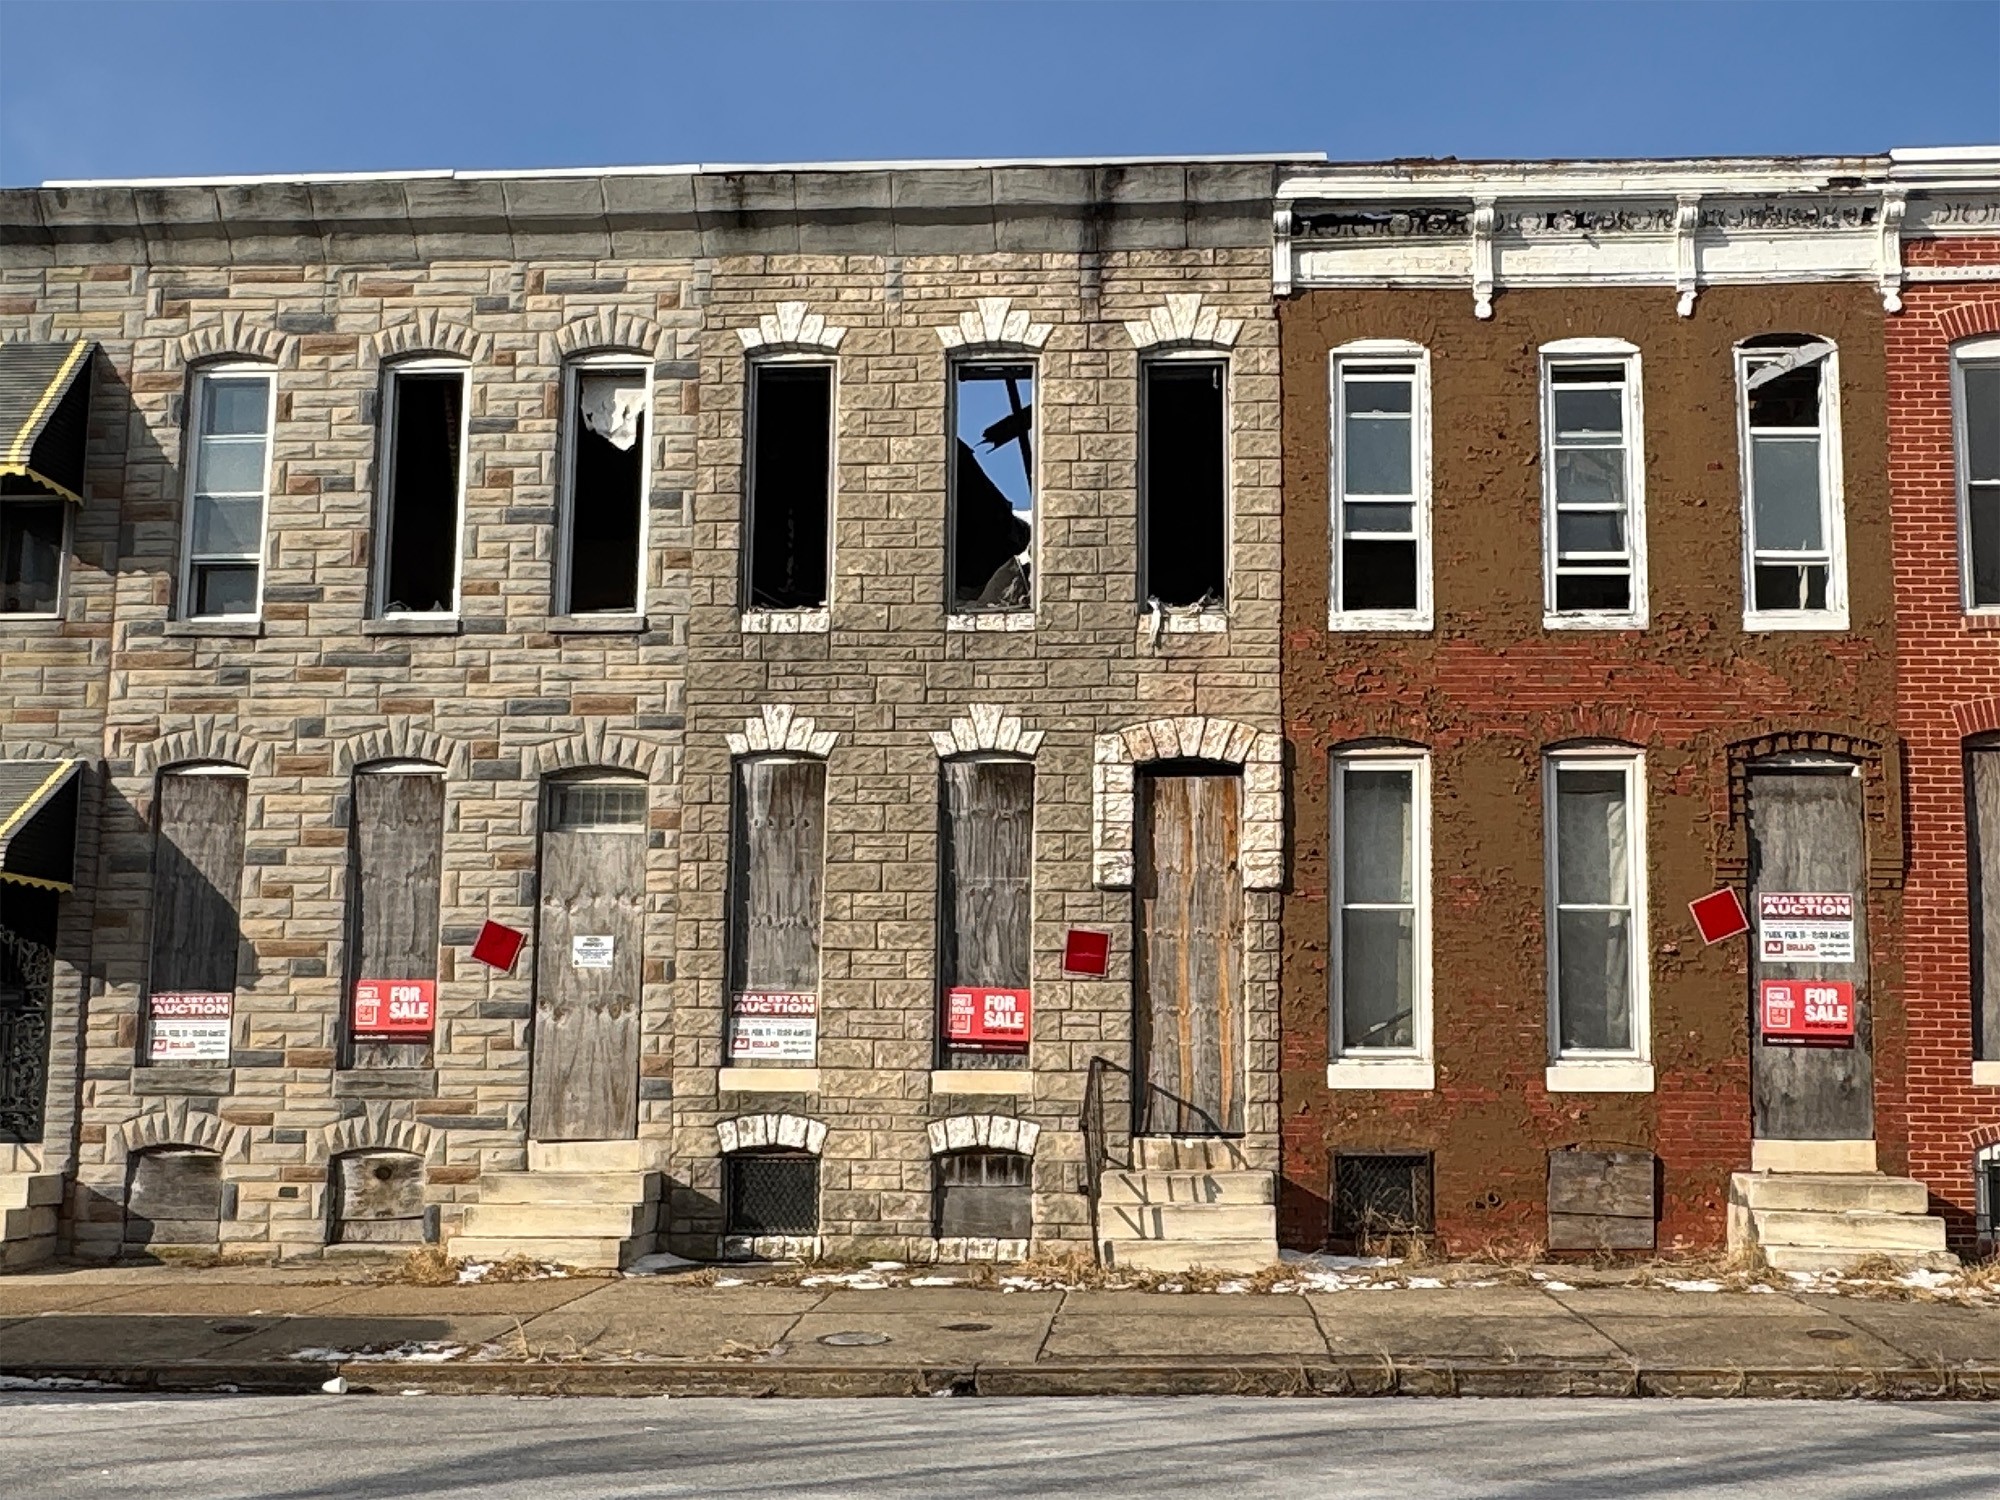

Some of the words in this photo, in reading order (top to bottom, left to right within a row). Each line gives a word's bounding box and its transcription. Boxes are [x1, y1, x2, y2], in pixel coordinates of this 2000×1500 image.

[1763, 896, 1797, 904] REAL
[1799, 896, 1849, 904] ESTATE
[1763, 904, 1851, 915] AUCTION
[151, 996, 182, 1004] REAL
[183, 995, 229, 1003] ESTATE
[391, 986, 421, 1002] FOR
[767, 995, 815, 1003] ESTATE
[1804, 987, 1838, 1005] FOR
[152, 1004, 228, 1014] AUCTION
[734, 1002, 815, 1013] AUCTION
[984, 995, 1016, 1011] FOR
[389, 1002, 429, 1019] SALE
[1804, 1004, 1848, 1022] SALE
[984, 1011, 1024, 1028] SALE
